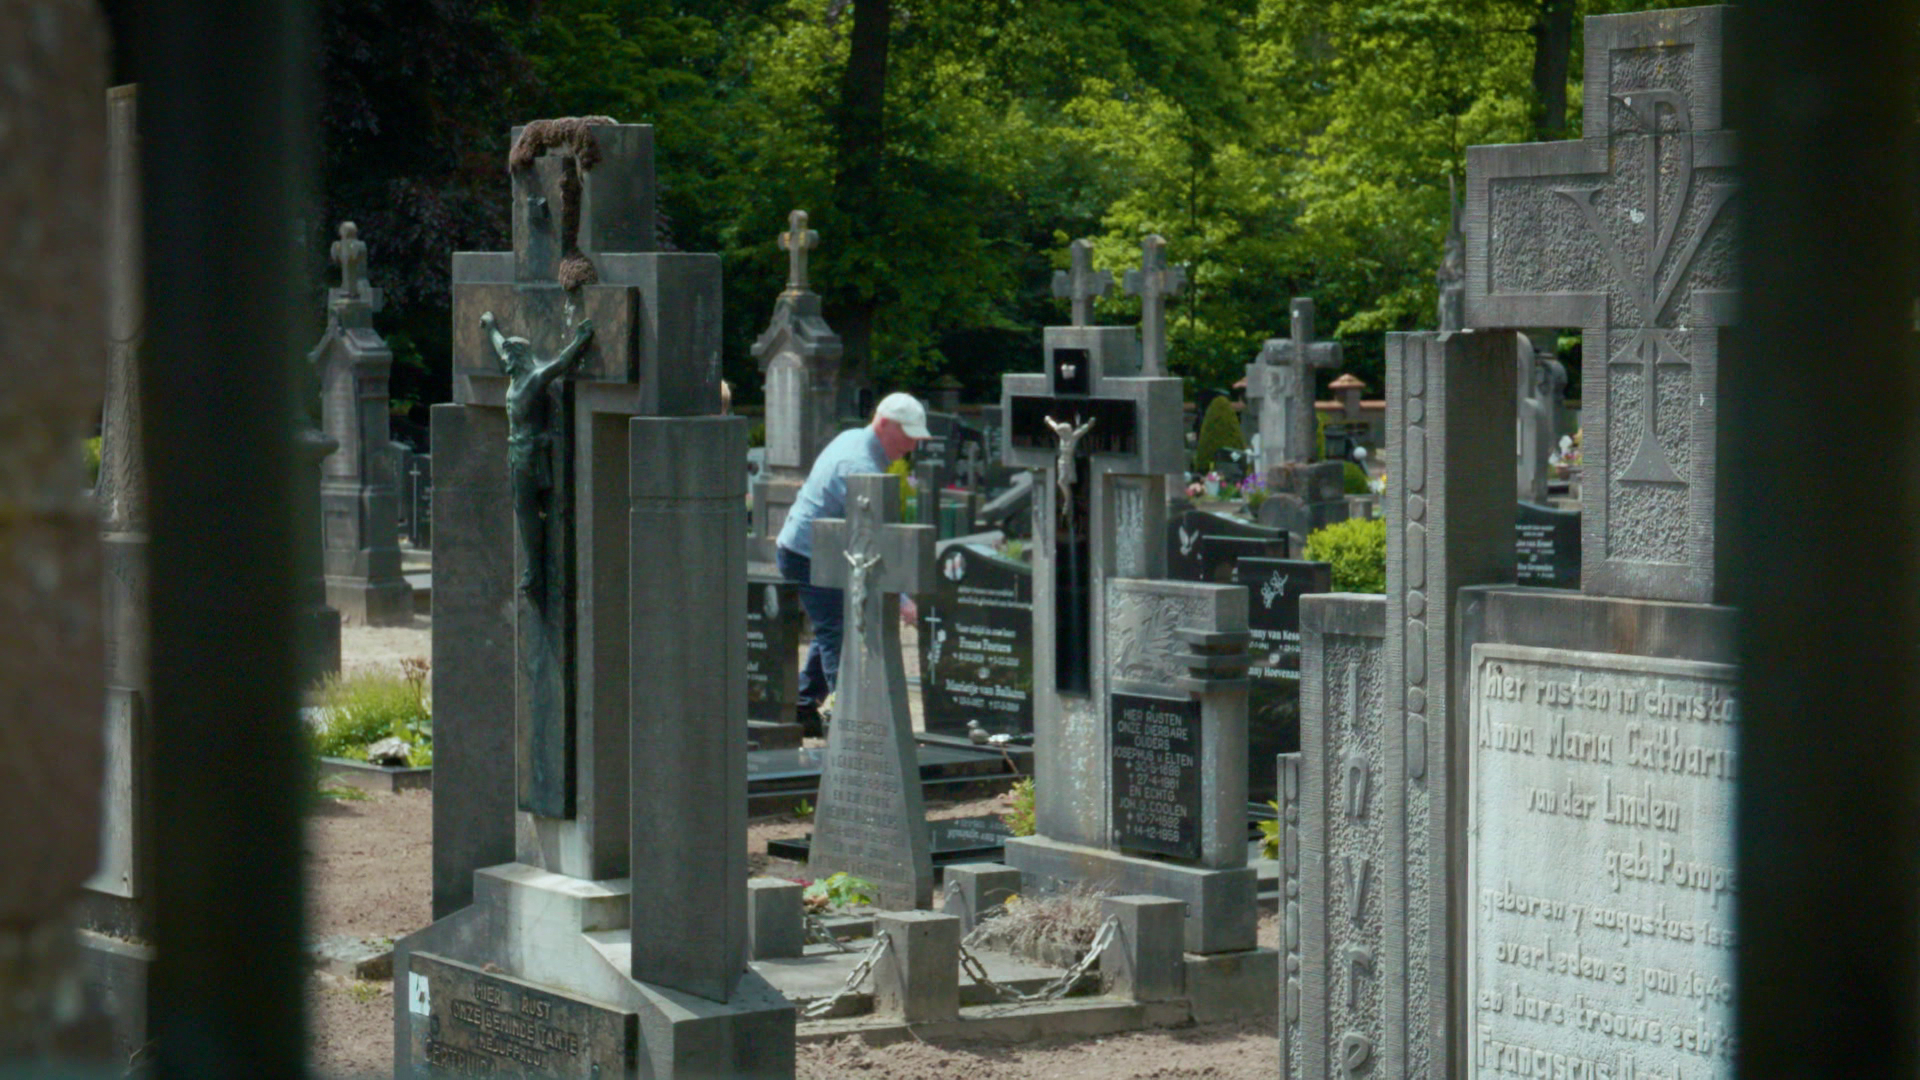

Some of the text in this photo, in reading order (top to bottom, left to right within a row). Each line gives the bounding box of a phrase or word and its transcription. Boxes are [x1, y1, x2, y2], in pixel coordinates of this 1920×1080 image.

[1535, 672, 1610, 710] rusten
[1117, 721, 1189, 740] ONZE DIERBARE
[1123, 709, 1182, 726] HIER RUSTEN
[1479, 706, 1534, 753] Anna
[1549, 714, 1613, 764] Maria
[1134, 736, 1170, 751] OUDERS
[1165, 752, 1193, 767] ELTEN
[1129, 784, 1141, 797] EN
[1150, 801, 1187, 818] COOLEN
[1526, 776, 1679, 830] van der Linden
[1480, 879, 1565, 921] geboren
[1593, 903, 1695, 946] augustus
[1496, 936, 1605, 982] overleden
[1611, 962, 1627, 984] 3
[1635, 967, 1677, 1001] juni
[474, 981, 551, 1020] HIER RUST
[1479, 989, 1504, 1013] en
[1512, 982, 1565, 1025] hare
[1576, 994, 1663, 1044] trouwe
[452, 999, 579, 1056] ONZE BEMINDE TANTE
[478, 1035, 548, 1070] MEJUFFROU
